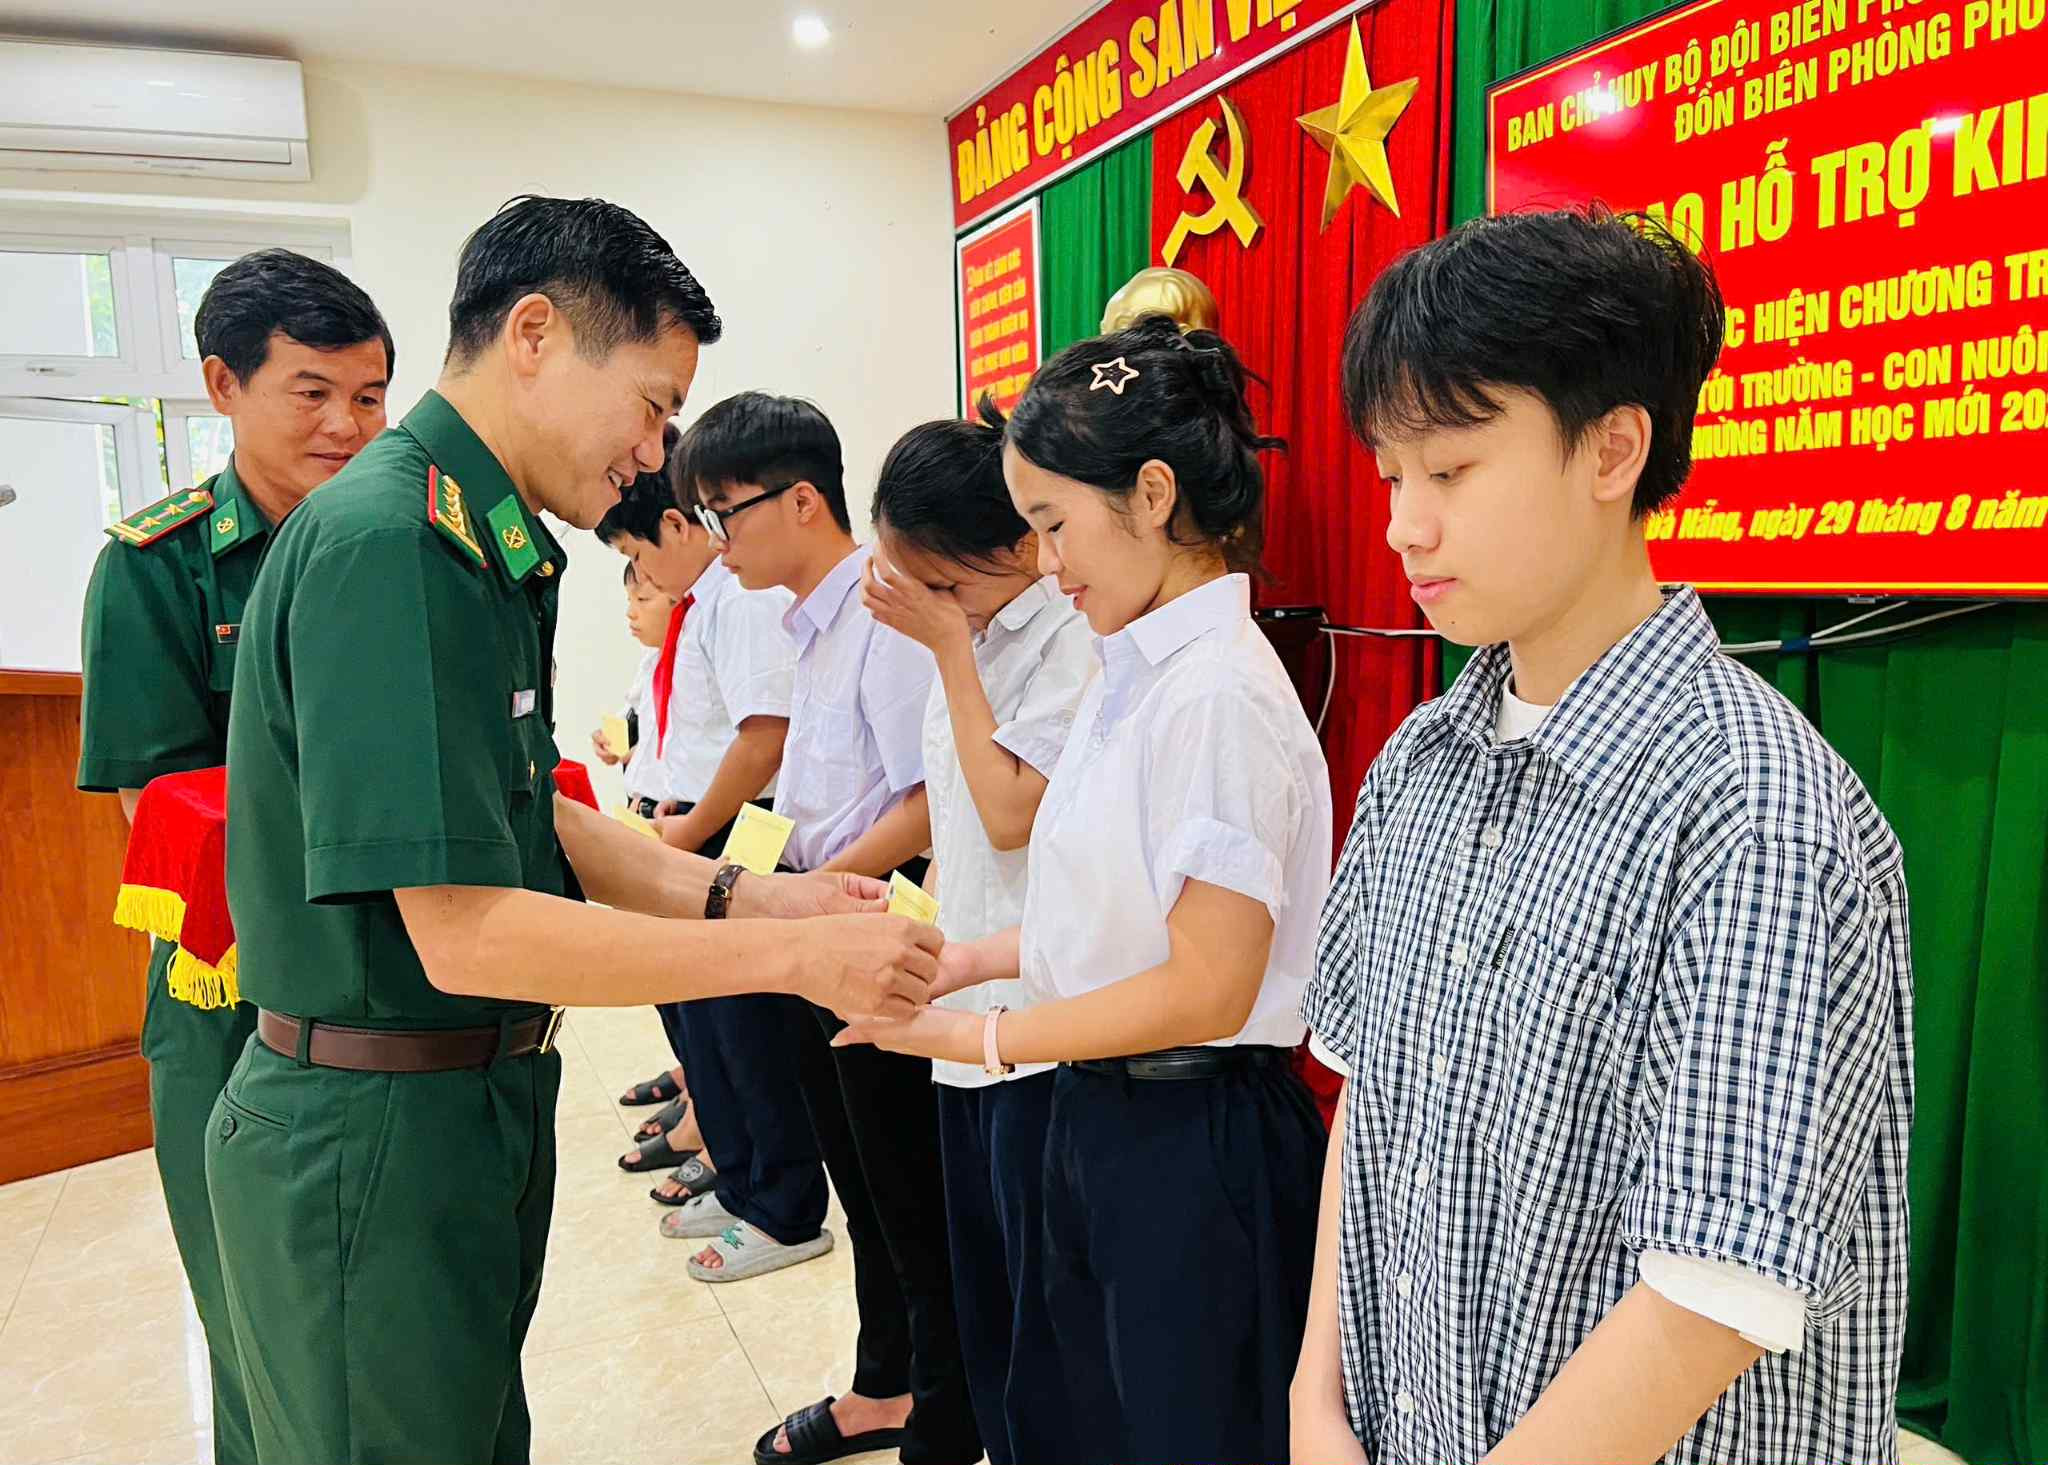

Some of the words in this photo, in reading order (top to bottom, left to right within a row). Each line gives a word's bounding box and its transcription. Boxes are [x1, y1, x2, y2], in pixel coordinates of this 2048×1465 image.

[957, 102, 1030, 204] ĐẢNG
[1034, 38, 1122, 160] CỘNG
[1507, 104, 1553, 152] BAN
[1607, 61, 1659, 115] HUY
[1665, 38, 1702, 95] BỘ
[1710, 19, 1760, 83] ĐỘI
[1675, 81, 1734, 143] ĐỒN
[1744, 63, 1819, 121] BIÊN
[1829, 13, 1951, 94] PHÒNG
[1719, 137, 1796, 253] HỖ
[1810, 116, 1936, 229] TRỢ
[1754, 288, 1830, 347] HIỆN
[1839, 260, 1993, 331] CHƯƠNG
[1741, 357, 1853, 409] TRƯỜNG
[1883, 345, 1952, 390] CON
[1775, 408, 1842, 453] NĂM
[1850, 403, 1914, 451] HỌC
[1924, 384, 1991, 438] MỚI
[2000, 387, 2048, 432] 20
[1748, 502, 1816, 540] ngày
[1813, 500, 1855, 535] 29
[1856, 499, 1942, 535] tháng
[1945, 494, 1972, 532] 8
